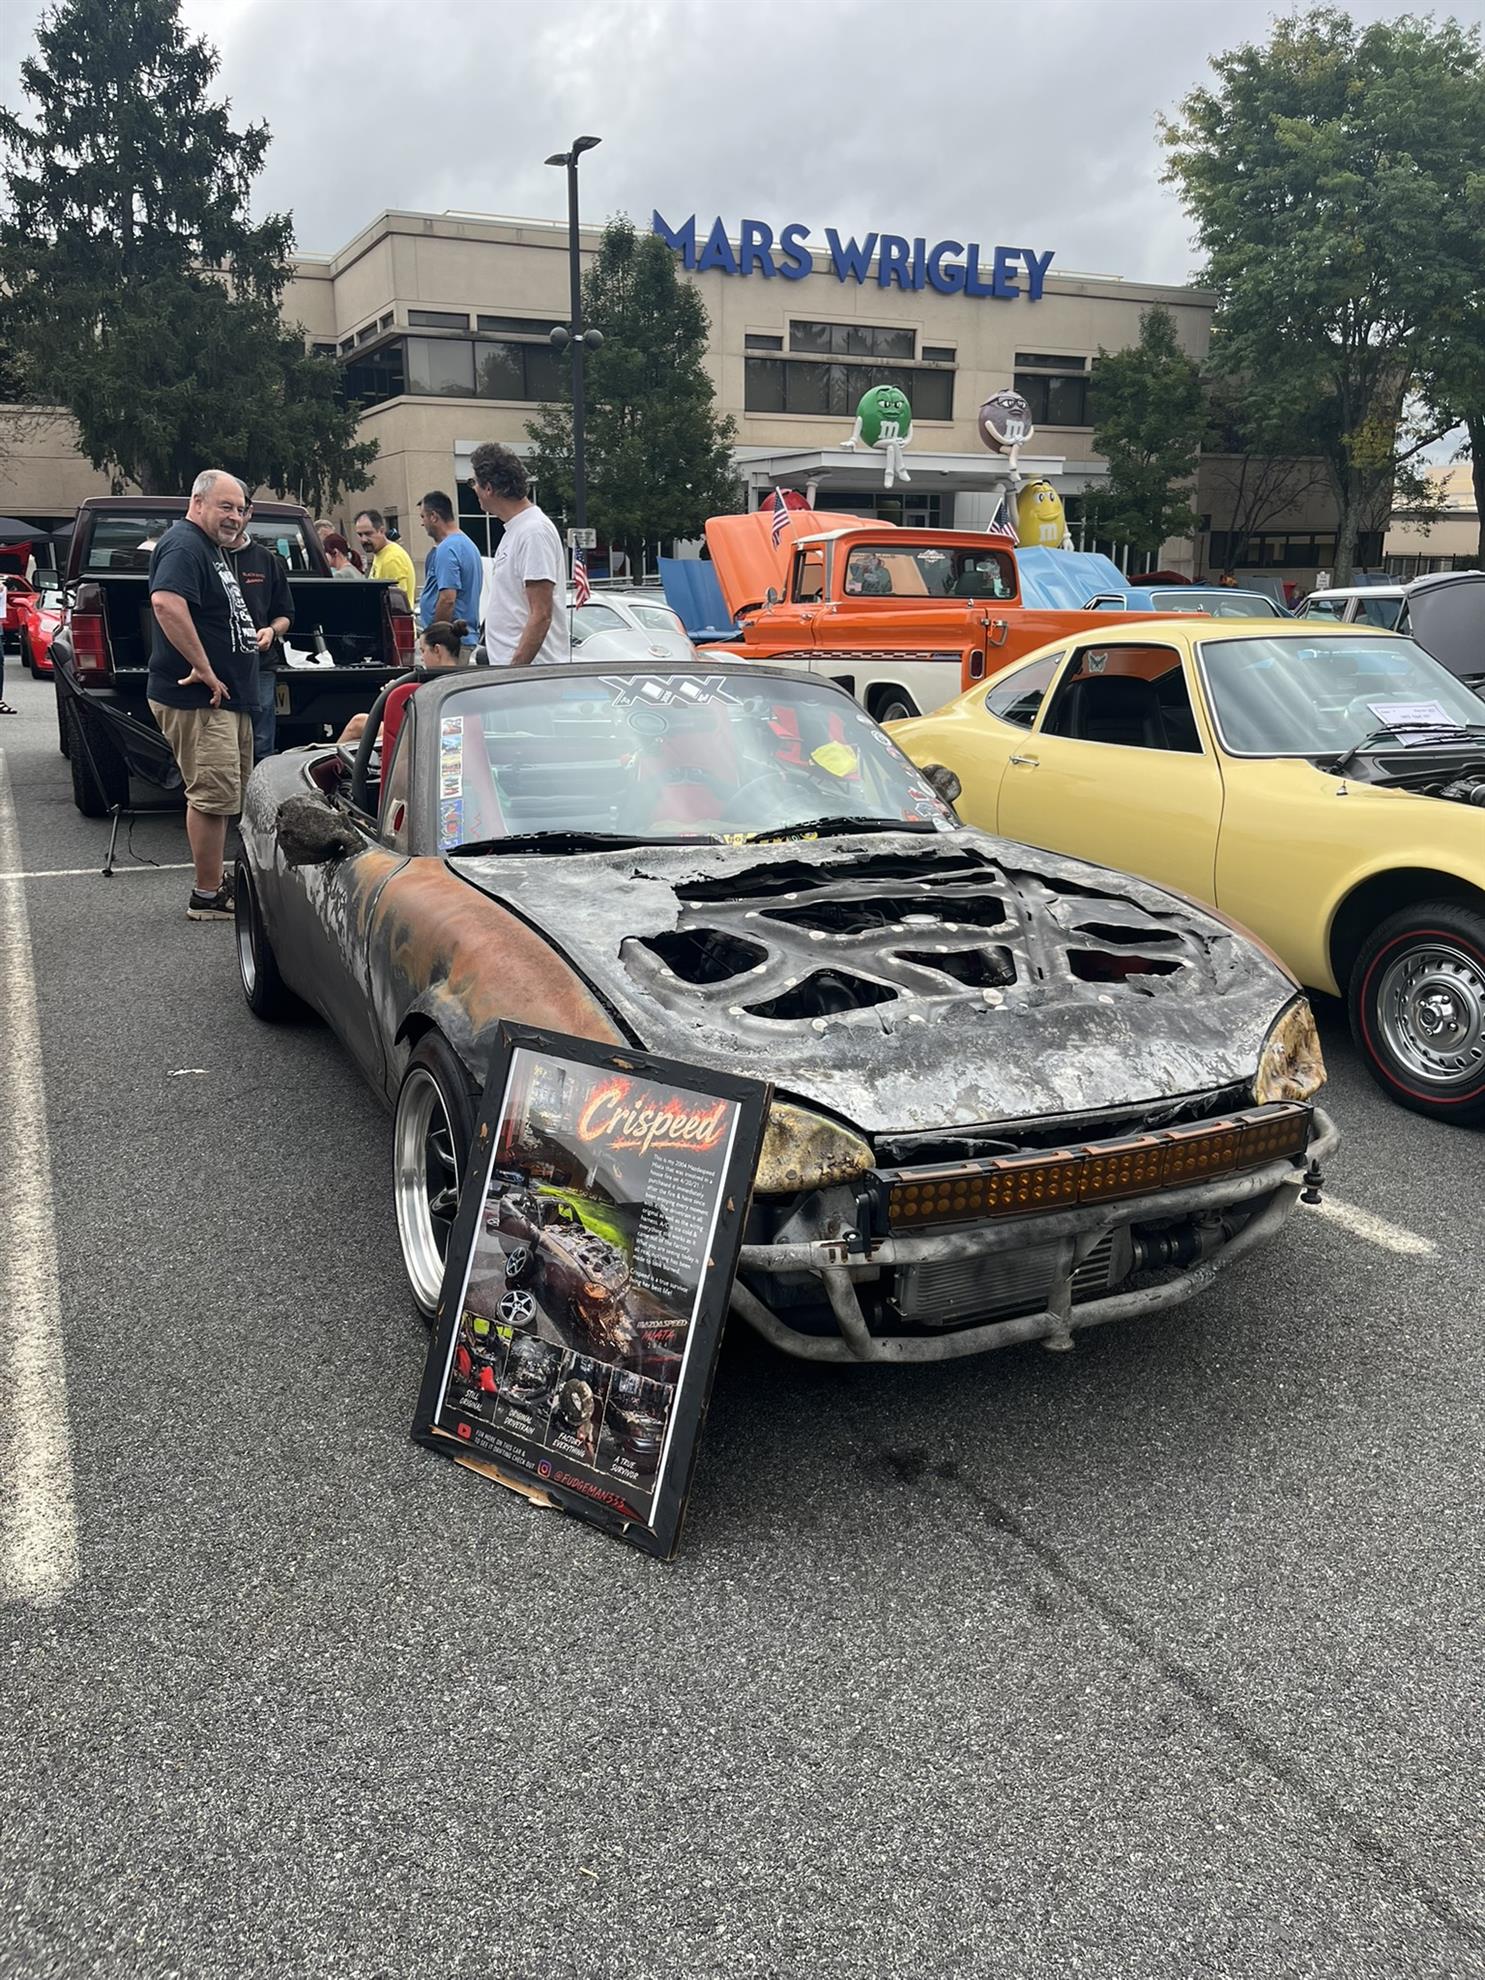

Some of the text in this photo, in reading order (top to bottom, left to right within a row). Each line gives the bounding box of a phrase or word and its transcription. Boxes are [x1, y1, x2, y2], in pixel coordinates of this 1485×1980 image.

[653, 209, 1055, 300] MARS WRIGLEY
[878, 420, 899, 439] m
[1040, 524, 1057, 541] m
[579, 1088, 725, 1157] Crispeed
[465, 1389, 479, 1400] STILL
[460, 1397, 482, 1412] ORIGINAL
[508, 1409, 532, 1424] ORIGINAL
[504, 1417, 535, 1434] DRIVETRAIN
[558, 1432, 583, 1447] FACTORY
[503, 1442, 513, 1451] THIS
[513, 1446, 522, 1455] CAR
[552, 1439, 586, 1458] EVERYTHING
[620, 1458, 636, 1469] TRUE
[610, 1464, 639, 1480] SURVIVOR
